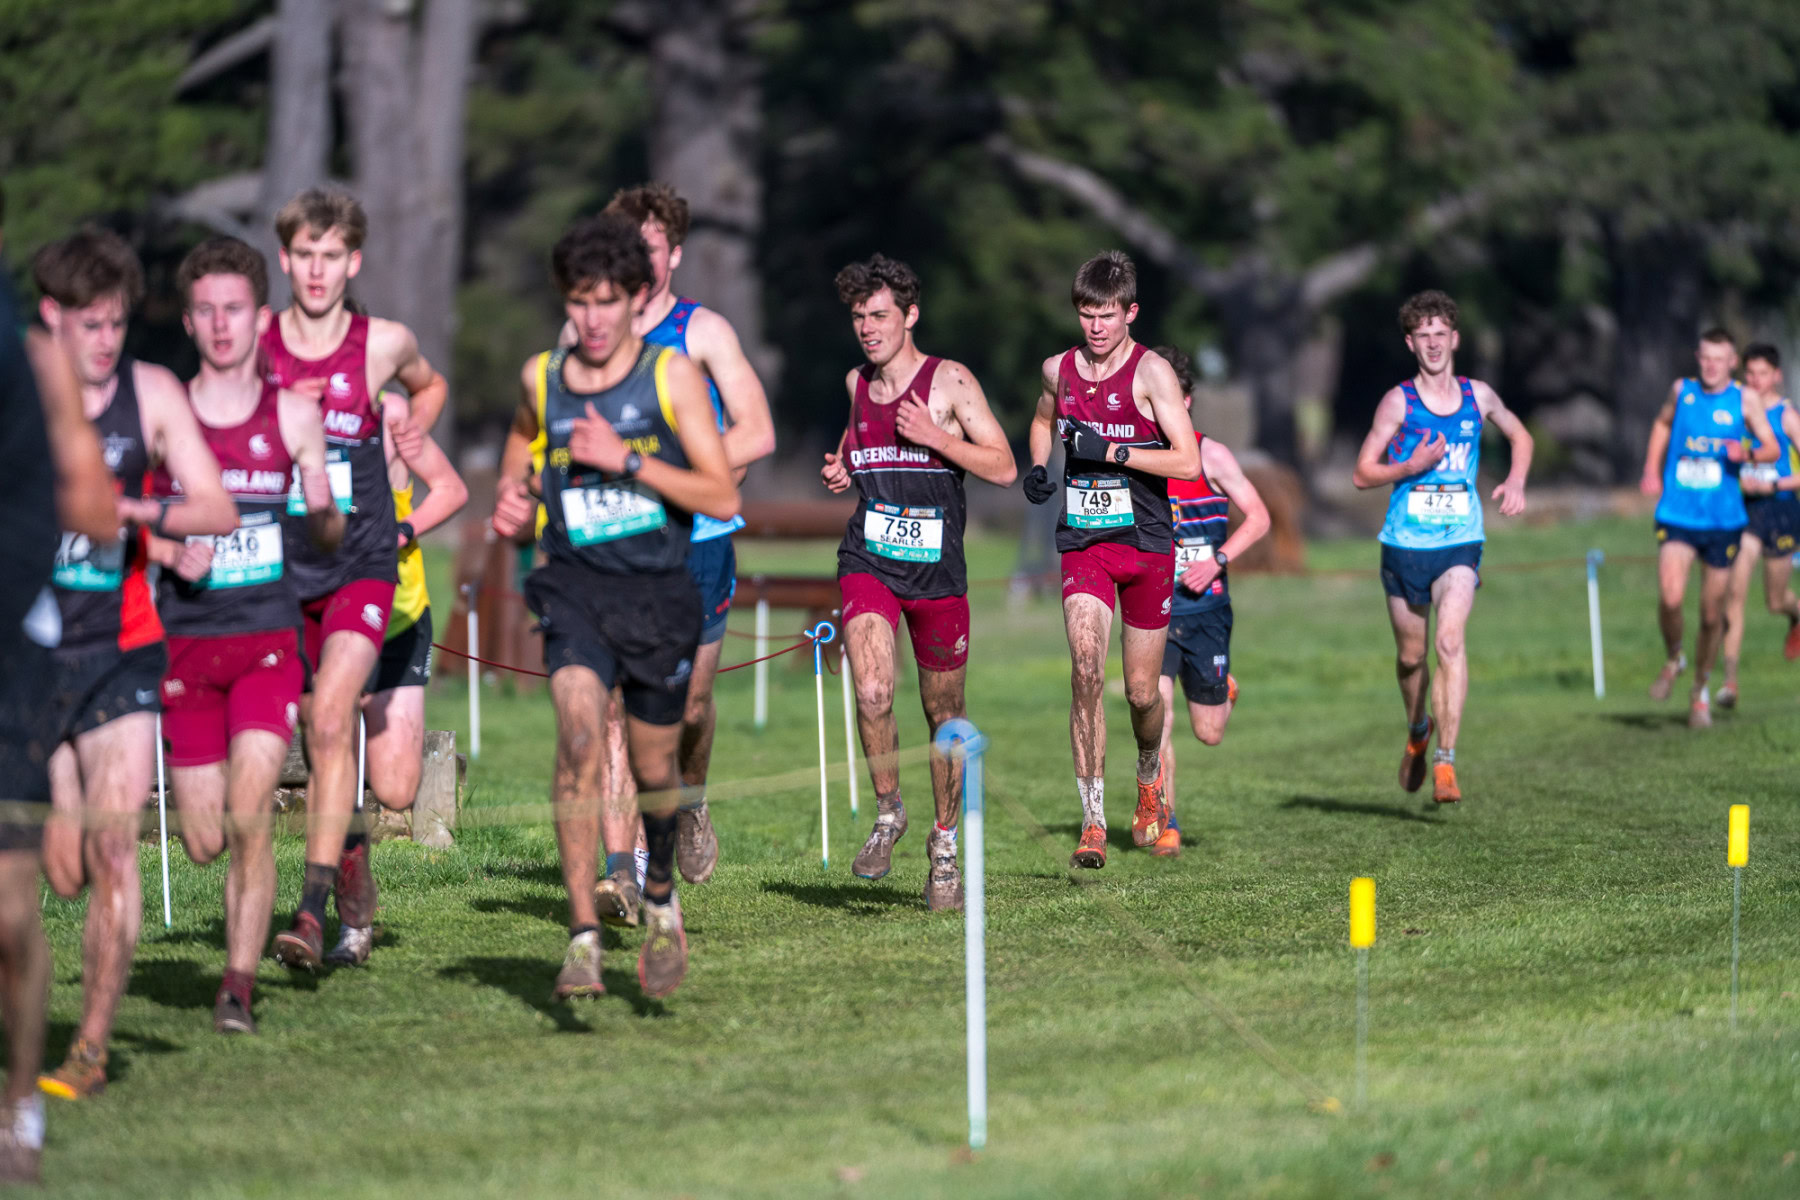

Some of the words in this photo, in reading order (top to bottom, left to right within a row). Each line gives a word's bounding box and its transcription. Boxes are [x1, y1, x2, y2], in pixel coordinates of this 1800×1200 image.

[1079, 491, 1112, 508] 749
[1424, 494, 1454, 508] 472
[1084, 508, 1109, 516] ROOS
[884, 517, 922, 539] 758
[880, 534, 924, 547] SEARLES
[1175, 548, 1200, 562] 47
